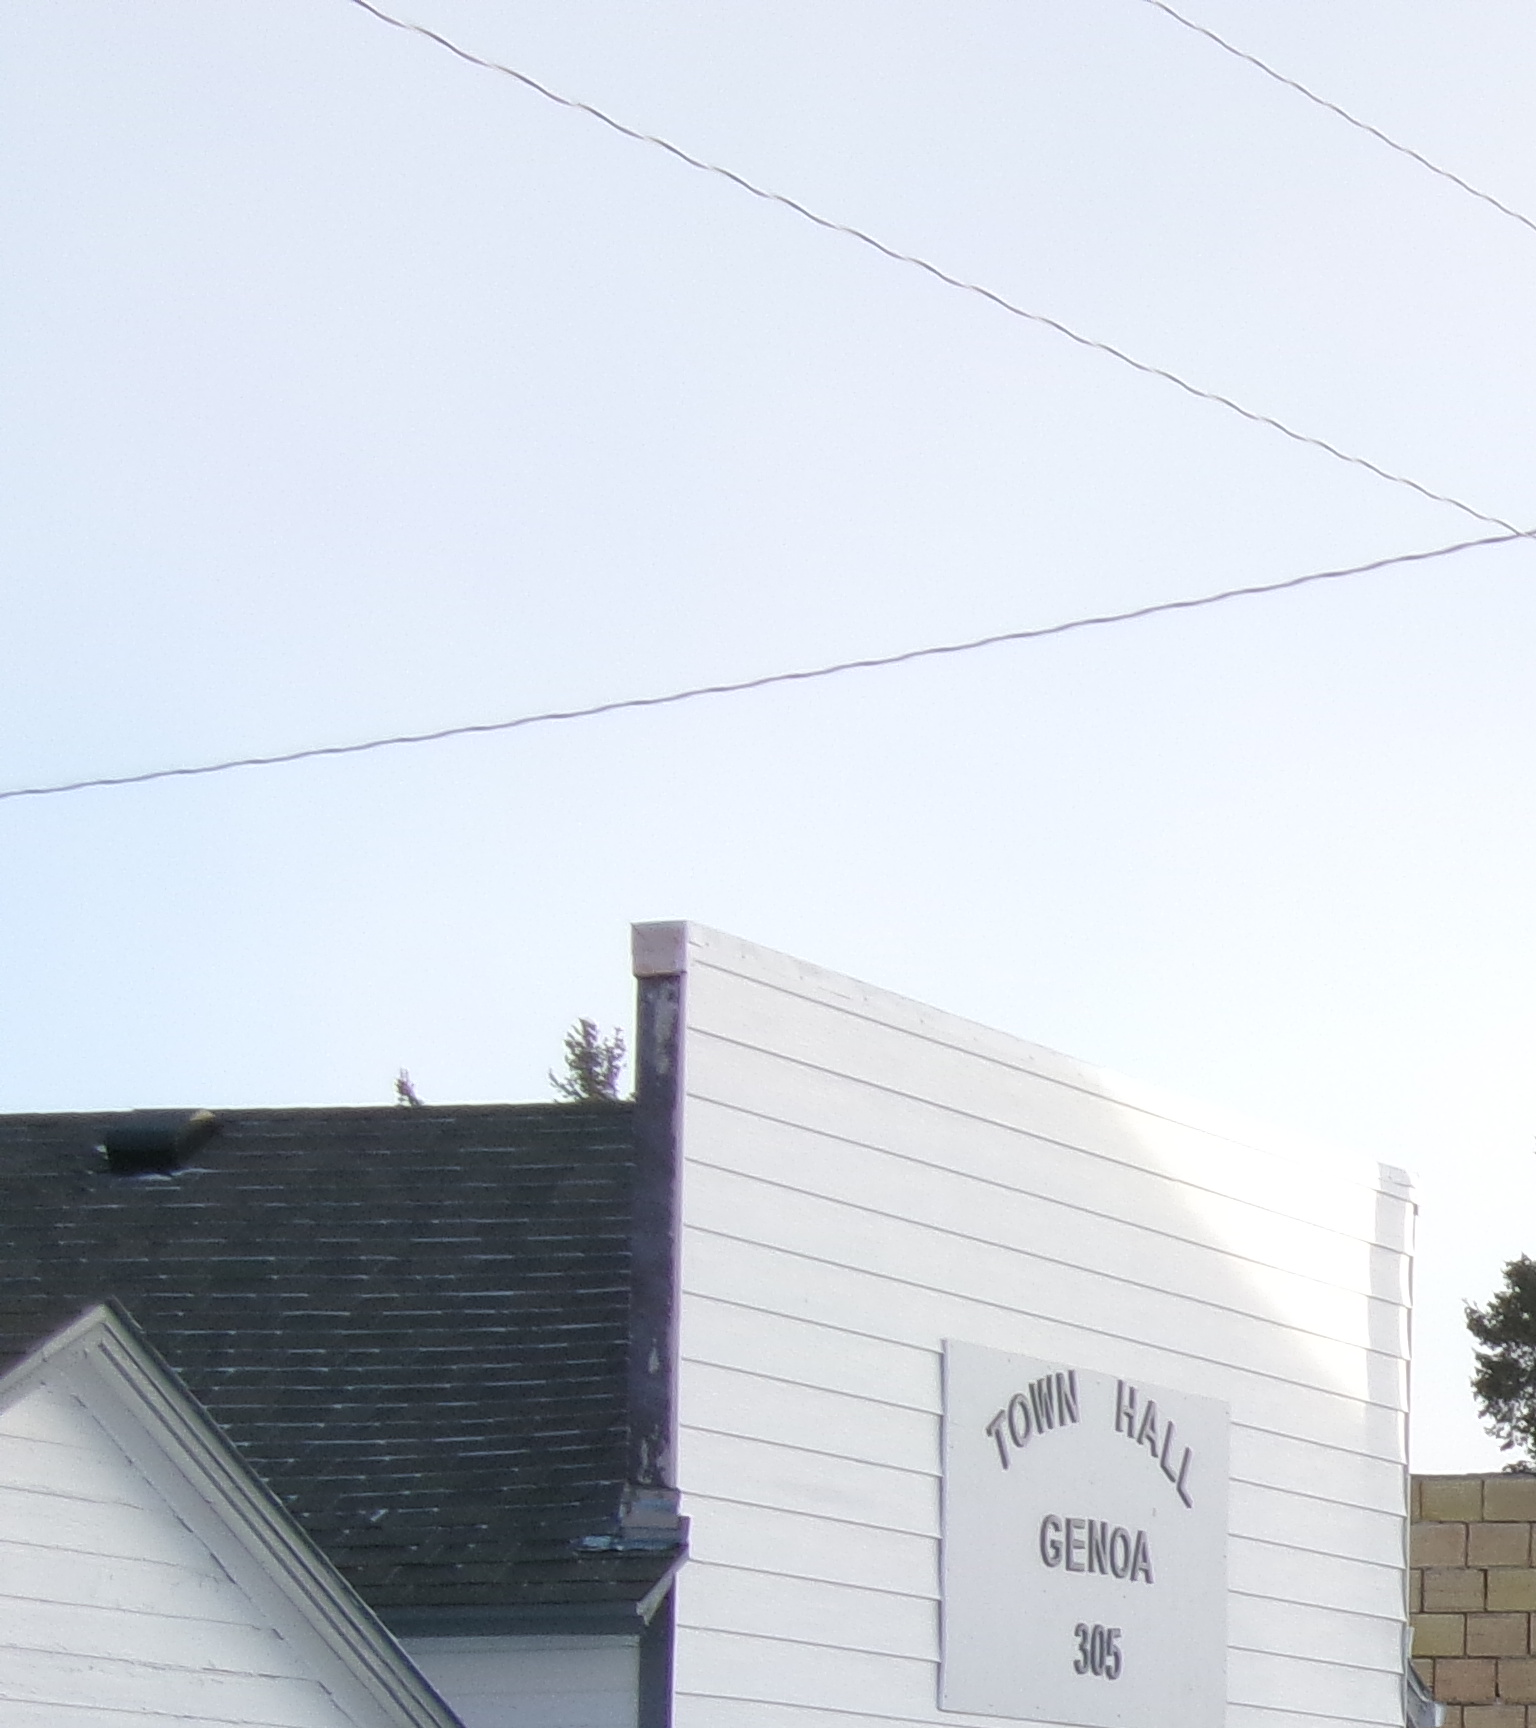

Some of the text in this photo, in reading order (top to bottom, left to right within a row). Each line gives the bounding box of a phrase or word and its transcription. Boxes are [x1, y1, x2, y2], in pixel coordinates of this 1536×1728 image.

[986, 1370, 1193, 1508] TOWN HALL
[1040, 1514, 1154, 1584] GENOA
[1074, 1623, 1122, 1679] 305
